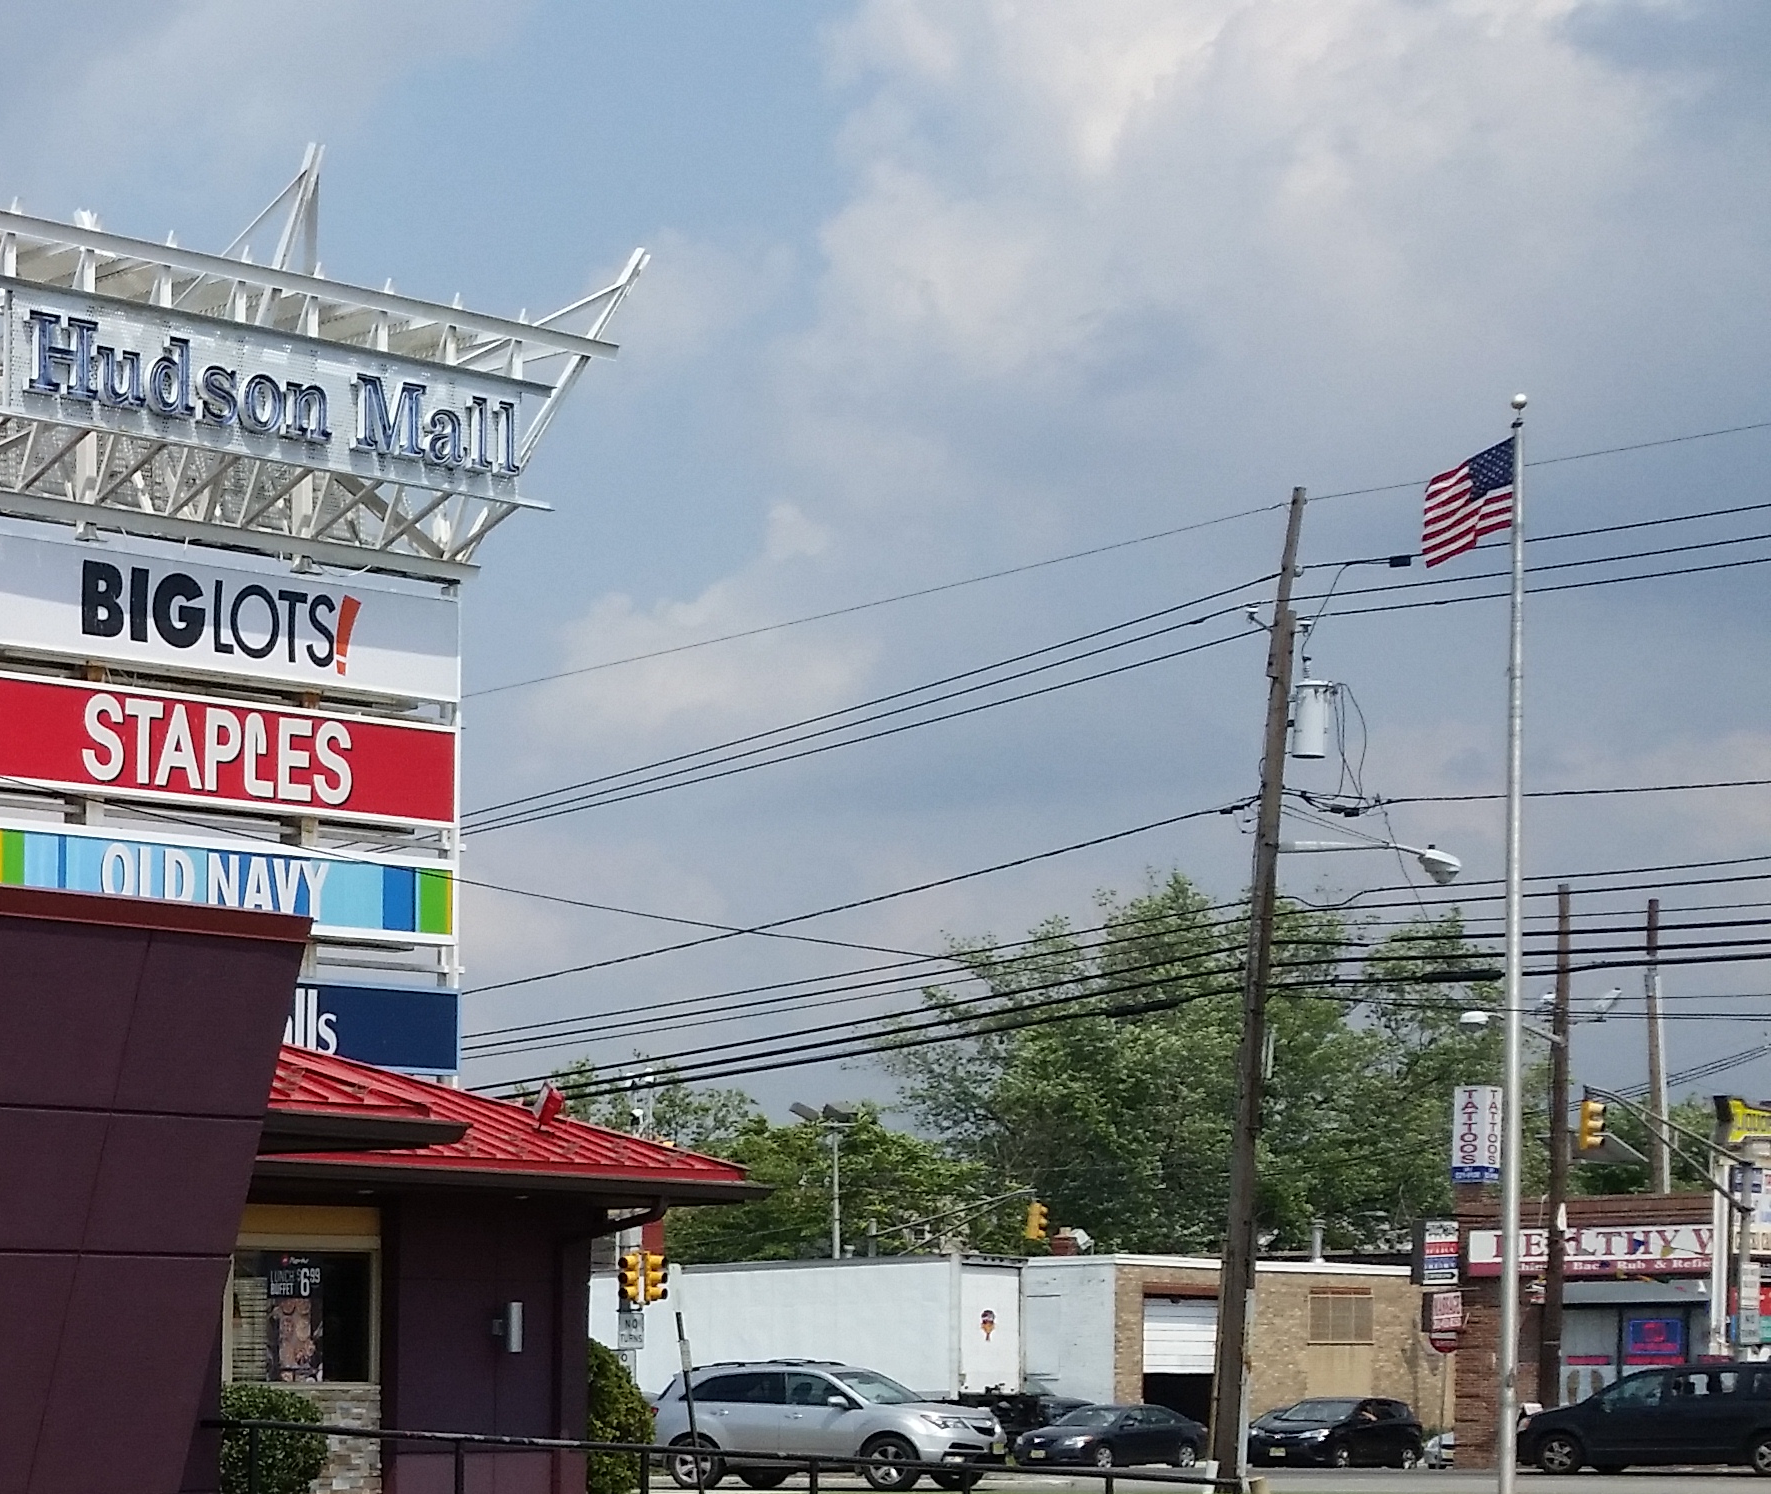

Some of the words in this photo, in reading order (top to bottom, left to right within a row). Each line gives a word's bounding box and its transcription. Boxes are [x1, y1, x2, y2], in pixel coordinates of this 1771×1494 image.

[23, 309, 333, 442] Hudson
[350, 372, 521, 477] Mall
[81, 559, 206, 648] BIG
[213, 580, 361, 676] LOTS!
[82, 693, 352, 804] STAPLES
[101, 842, 196, 903] OLD
[208, 852, 330, 920] NAVY
[283, 988, 338, 1055] lls
[1461, 1090, 1478, 1164] TATTOOS
[1488, 1090, 1498, 1164] TATTOOS
[270, 1269, 295, 1283] LUNCH
[270, 1282, 294, 1295] BUFFET
[1617, 1260, 1646, 1270] Rub
[625, 1318, 638, 1329] NO
